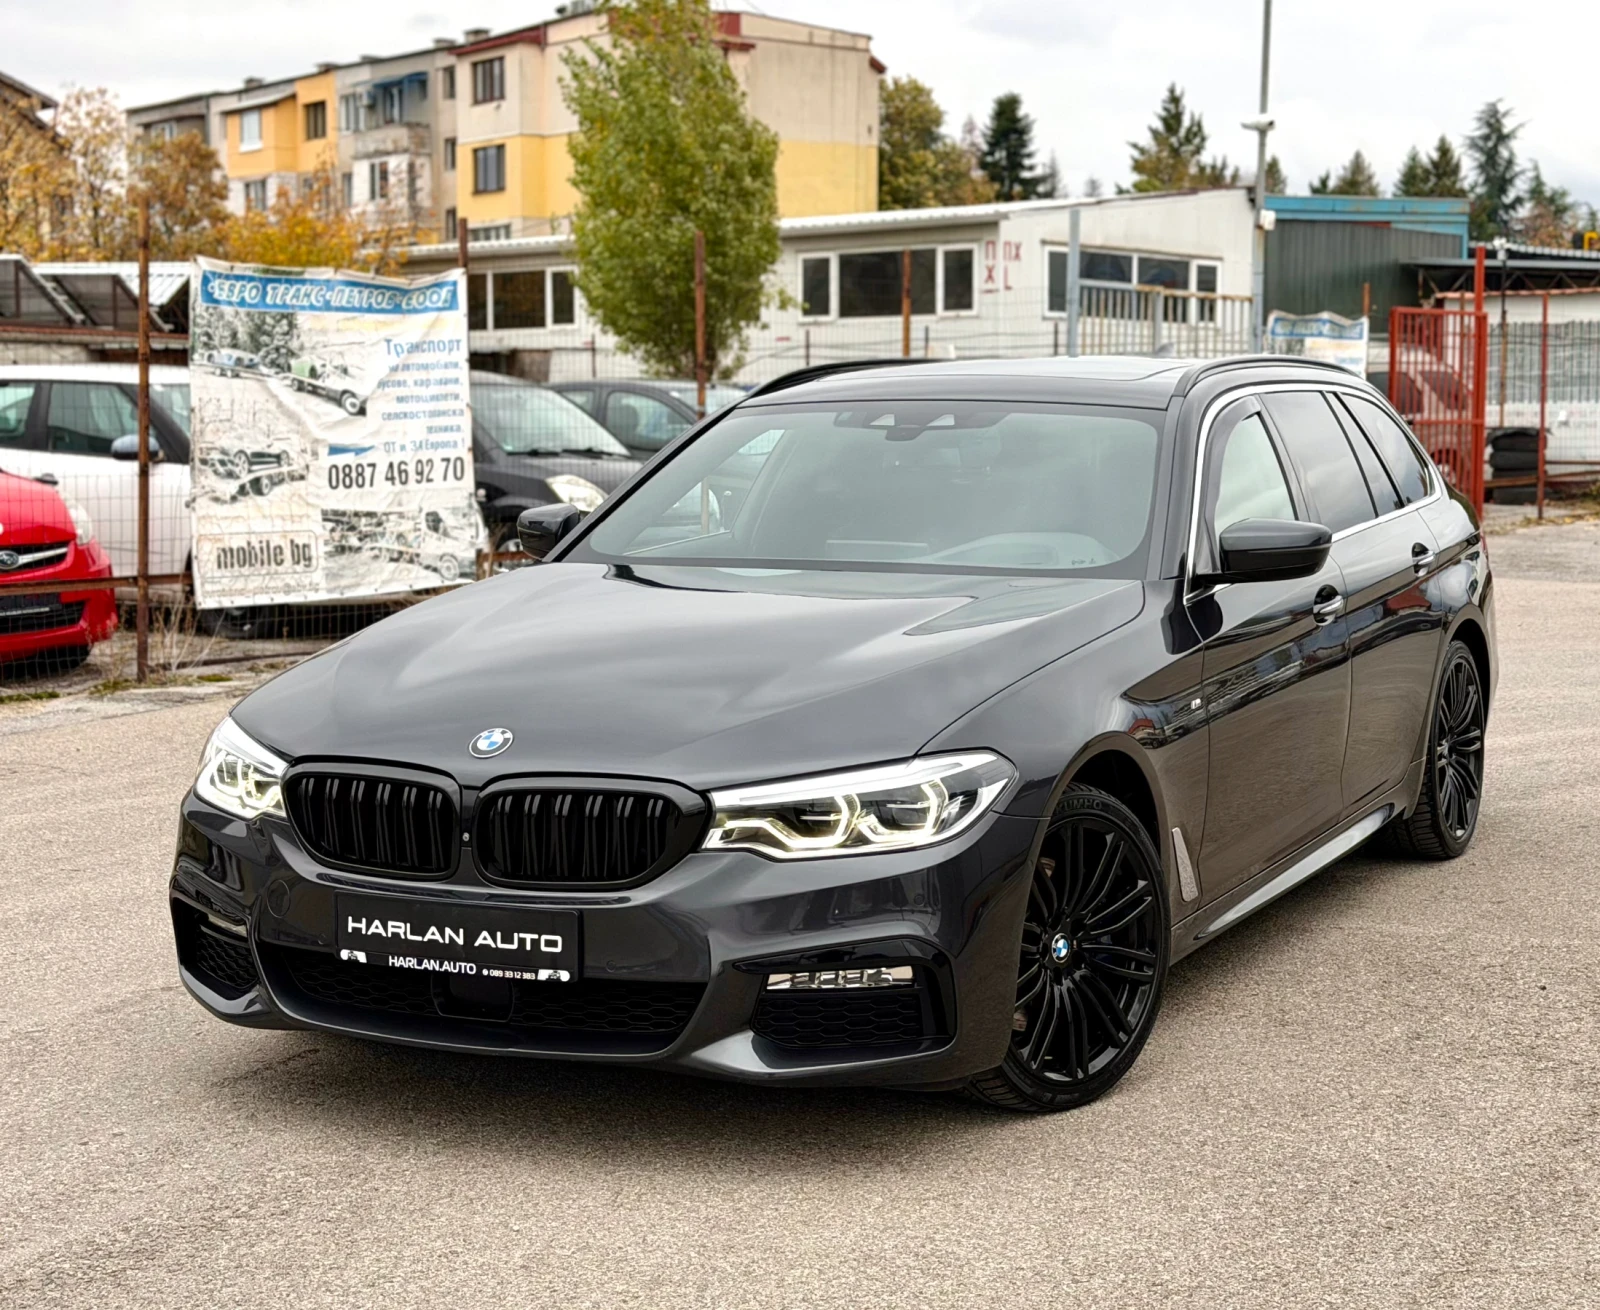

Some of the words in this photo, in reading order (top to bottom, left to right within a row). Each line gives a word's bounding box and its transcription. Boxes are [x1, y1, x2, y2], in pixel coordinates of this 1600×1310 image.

[384, 339, 462, 358] Транспорт
[328, 463, 377, 490] 0887
[384, 460, 409, 486] 46
[415, 458, 434, 484] 92
[440, 456, 465, 482] 70
[216, 540, 285, 569] mobile
[290, 539, 312, 568] bg
[348, 916, 464, 945] HARLAN
[474, 931, 562, 953] AUTO
[389, 956, 476, 975] HARLAN.AUTO
